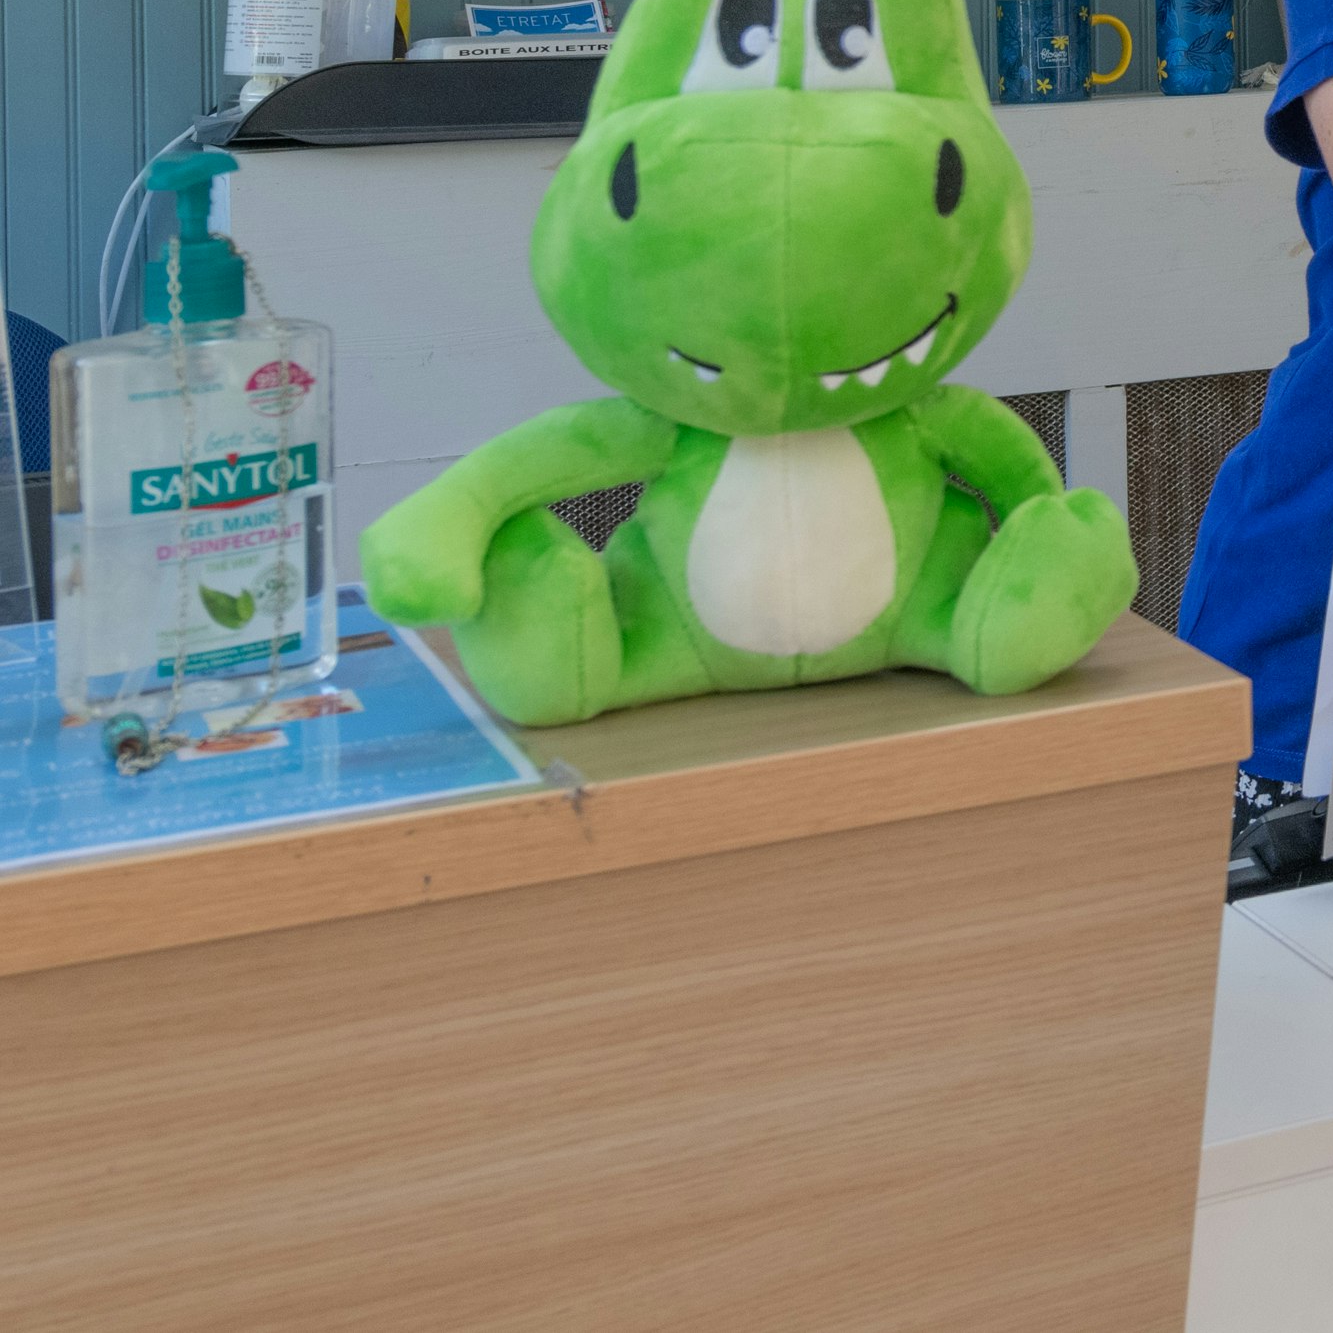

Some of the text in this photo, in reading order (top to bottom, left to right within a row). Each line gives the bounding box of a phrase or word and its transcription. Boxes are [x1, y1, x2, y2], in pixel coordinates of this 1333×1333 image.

[497, 13, 571, 27] ETRETAT
[459, 47, 511, 56] BOITE
[516, 45, 550, 54] AUX
[141, 453, 311, 506] SANYTOL
